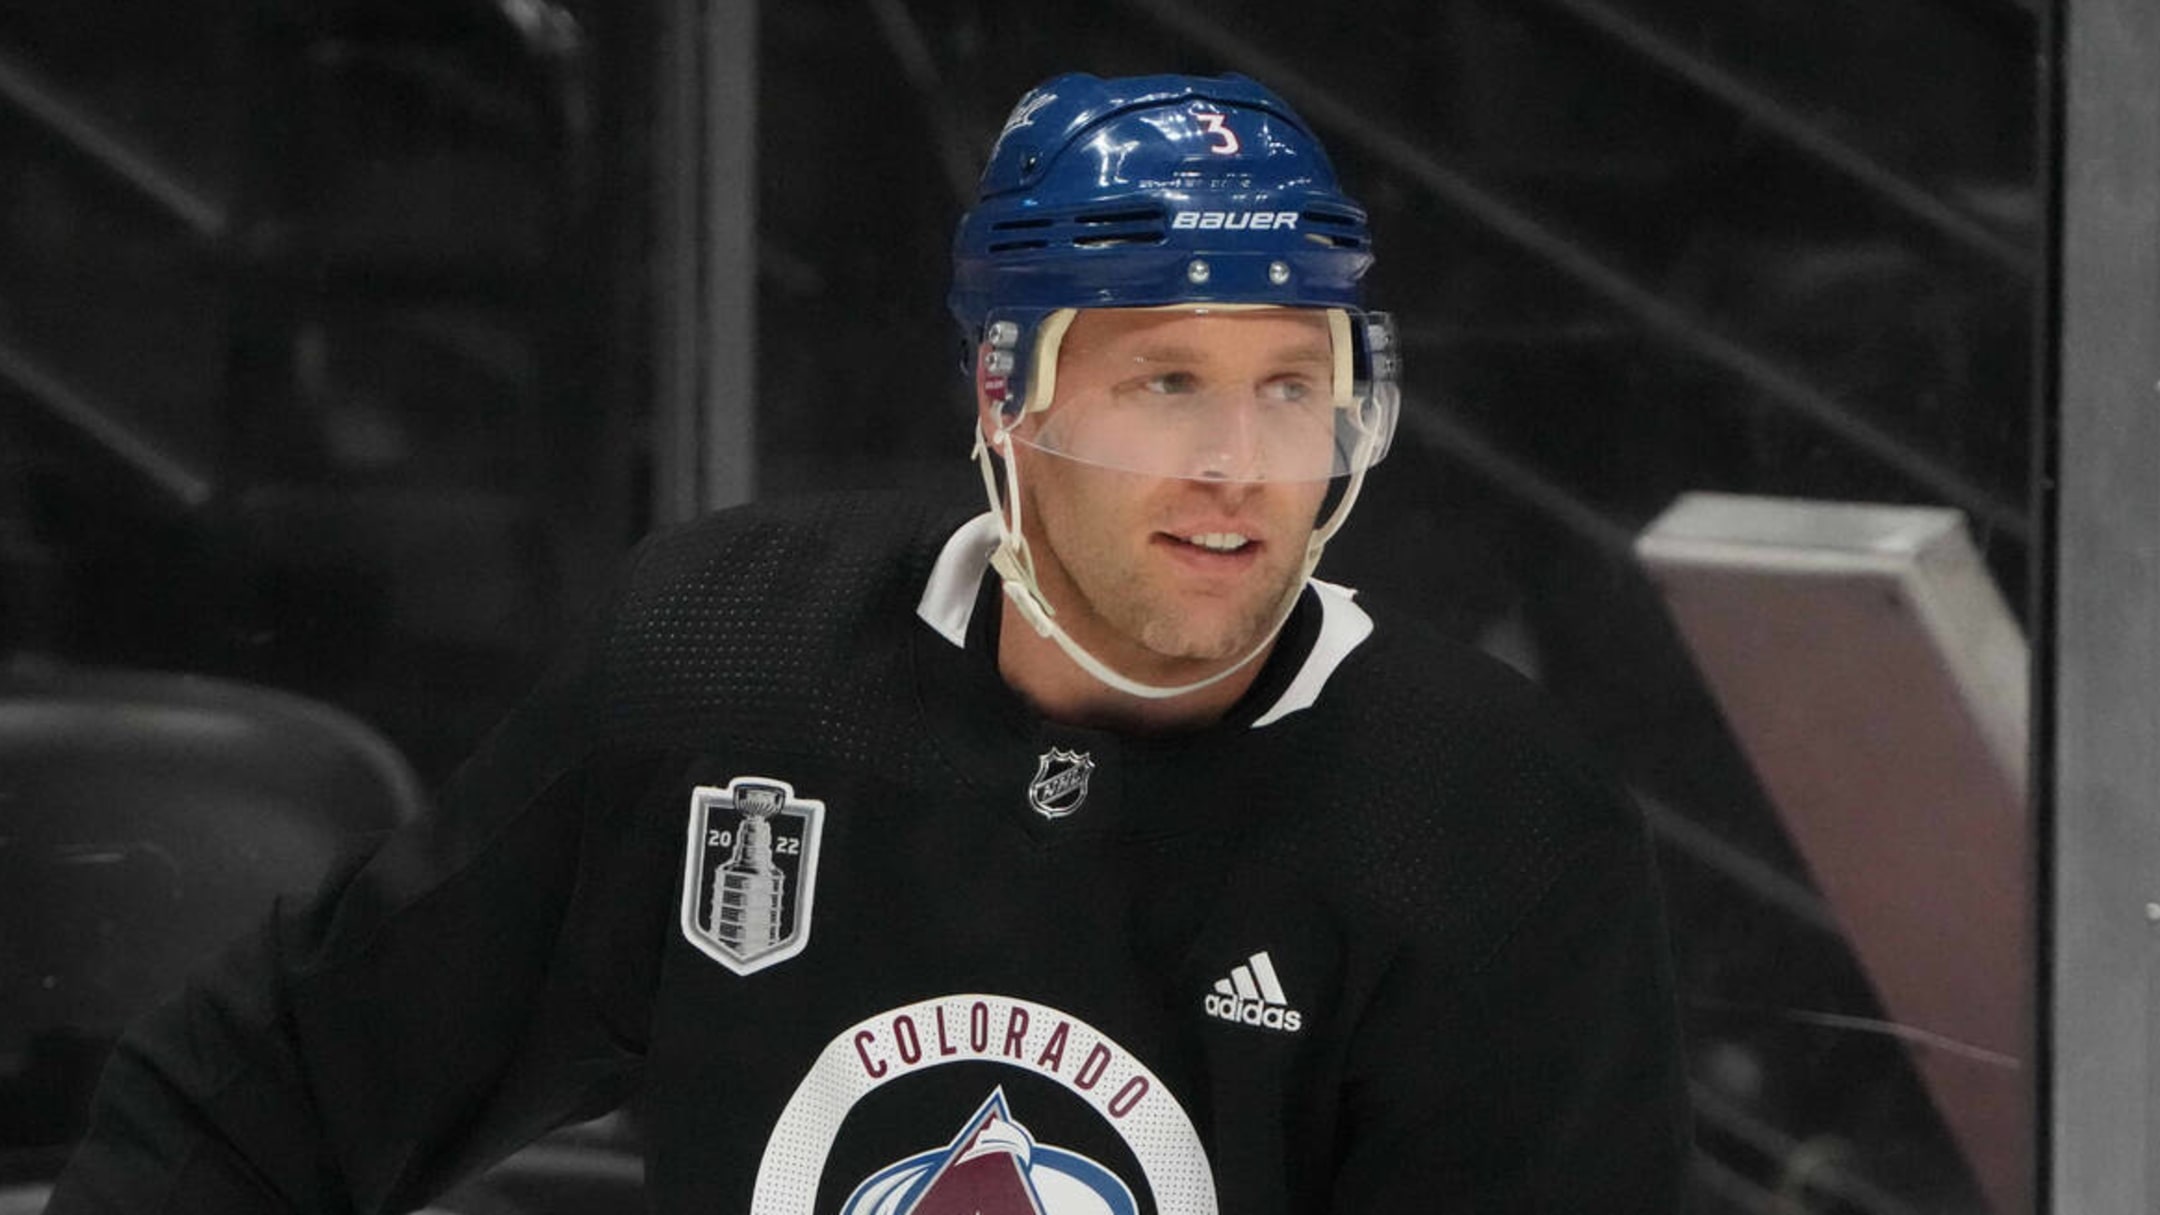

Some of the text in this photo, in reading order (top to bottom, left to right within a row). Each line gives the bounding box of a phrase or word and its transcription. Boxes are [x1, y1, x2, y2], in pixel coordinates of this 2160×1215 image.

[1196, 113, 1240, 156] 3
[1171, 211, 1299, 230] BAUER
[707, 829, 800, 855] 20 22
[1205, 994, 1301, 1032] adidas
[854, 1001, 1150, 1119] COLORADO
